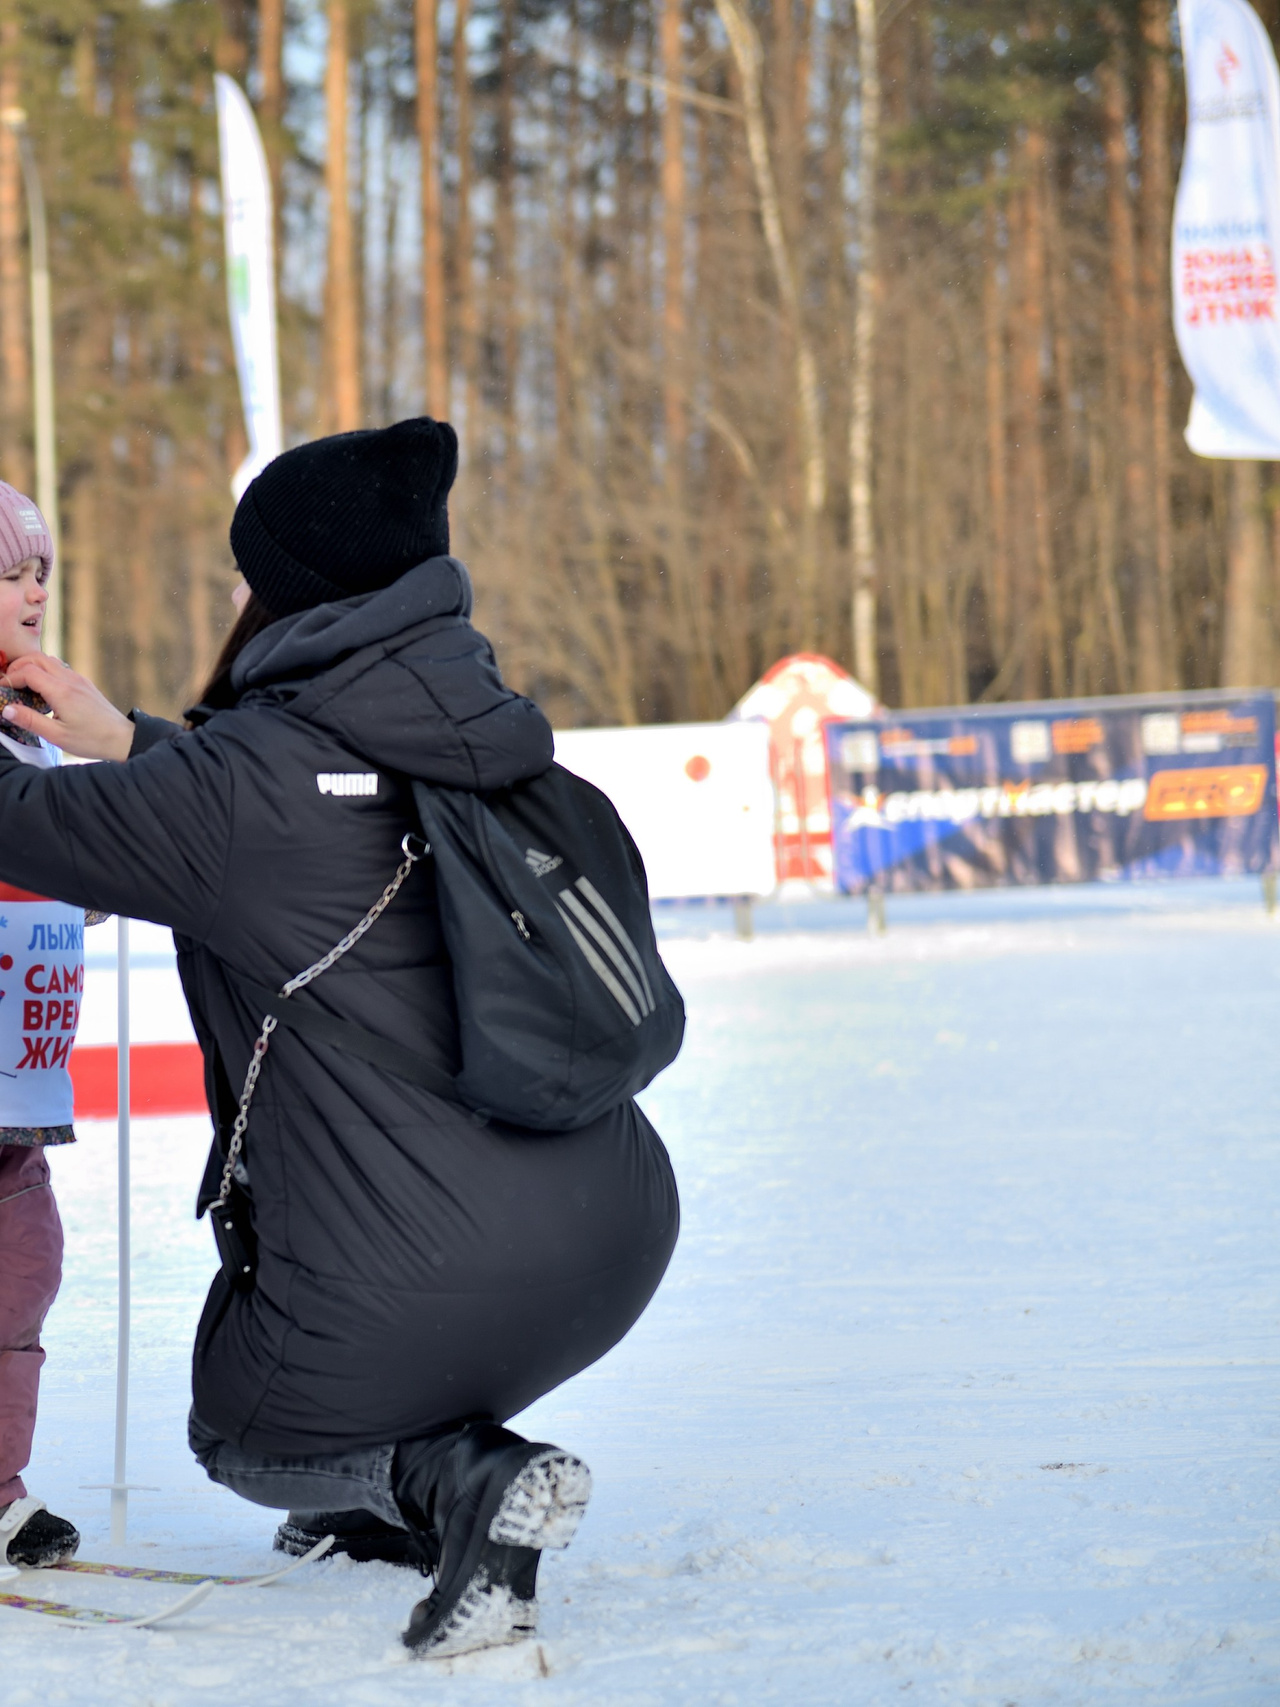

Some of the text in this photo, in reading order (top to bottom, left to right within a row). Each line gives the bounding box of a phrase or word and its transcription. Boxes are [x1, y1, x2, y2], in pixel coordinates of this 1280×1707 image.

[317, 772, 379, 796] PUMA
[532, 855, 564, 878] didas
[15, 1035, 75, 1070] ЖИ
